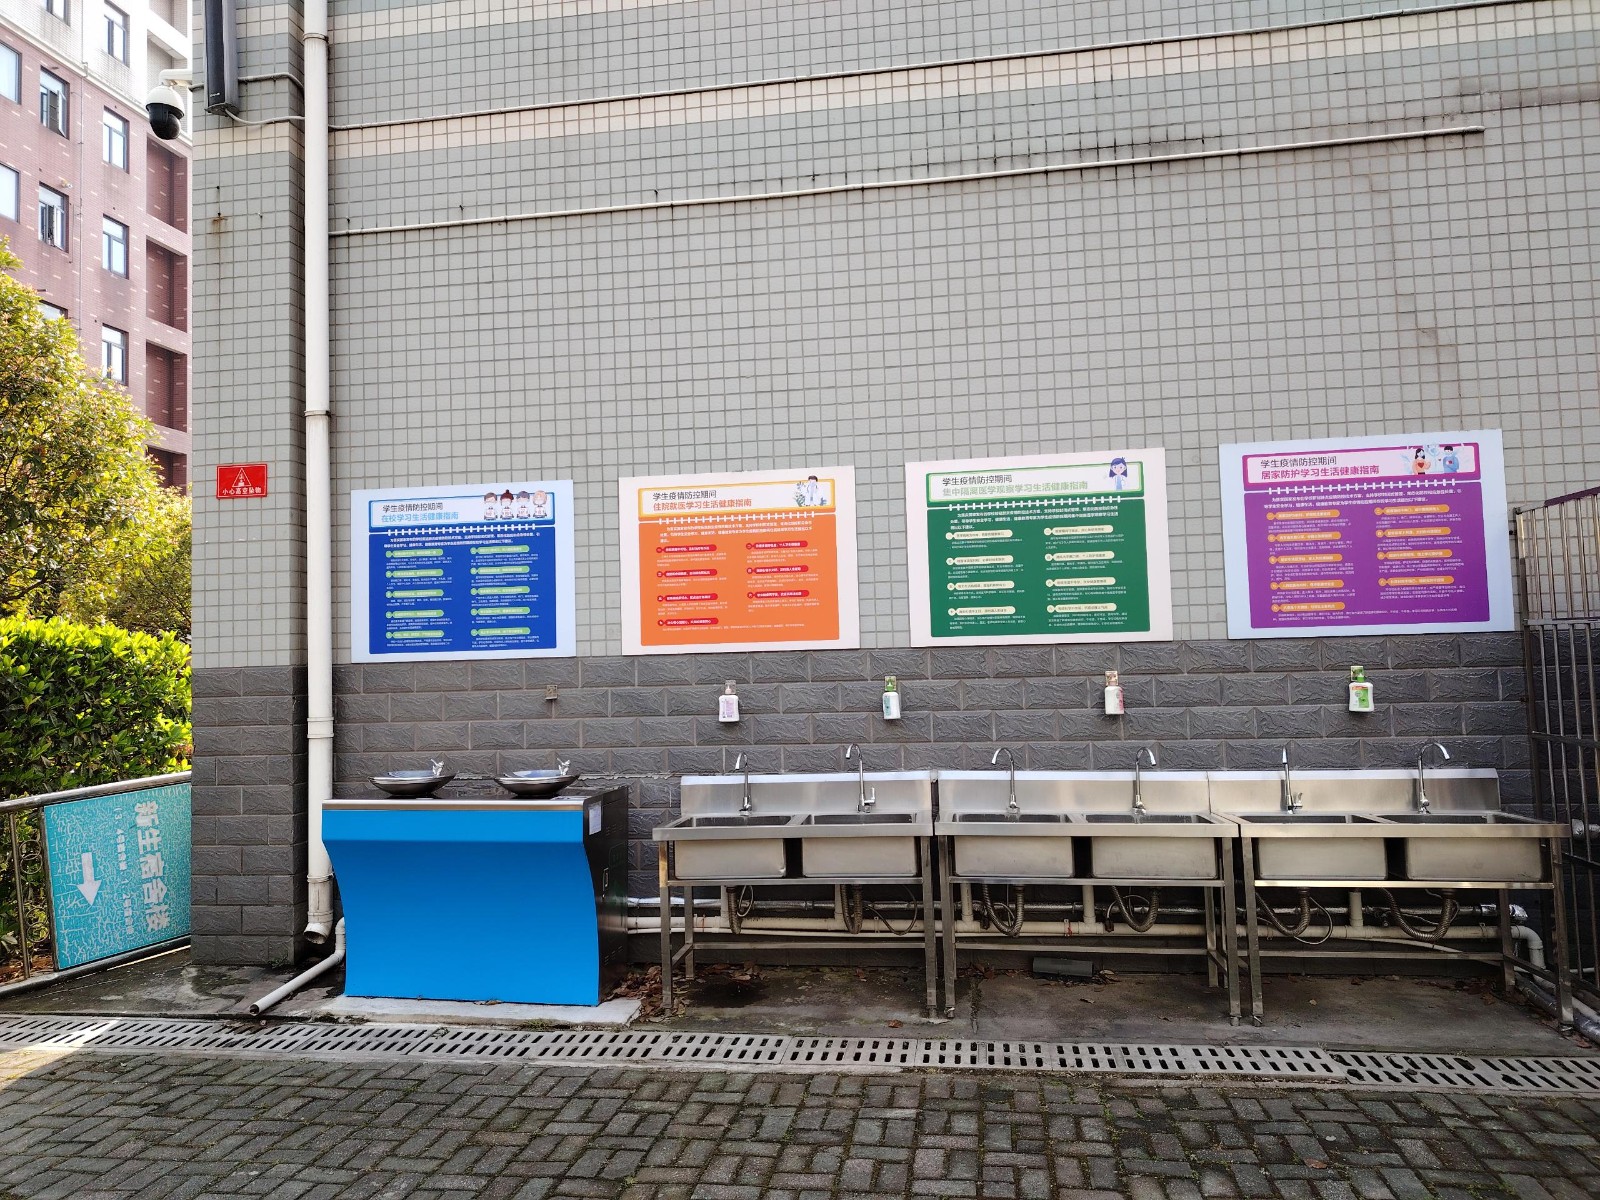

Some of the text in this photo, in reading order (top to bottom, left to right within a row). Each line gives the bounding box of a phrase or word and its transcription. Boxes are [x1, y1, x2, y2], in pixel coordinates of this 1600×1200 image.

[1261, 456, 1337, 468] 学生疫情防控期间
[1261, 465, 1380, 480] 居家防护学习生活健康指南
[942, 474, 1013, 487] 学生疫情防控期间
[943, 481, 1088, 497] 集中隔离医学观察学习生活健康指南
[652, 490, 717, 501] 学生疫情防控期间
[382, 502, 444, 514] 学生疫情防控期间
[653, 499, 752, 511] 住院就医学习生活健康指南
[381, 511, 459, 523] 在校学习生活健康指南
[135, 801, 171, 932] 新生宿舍楼
